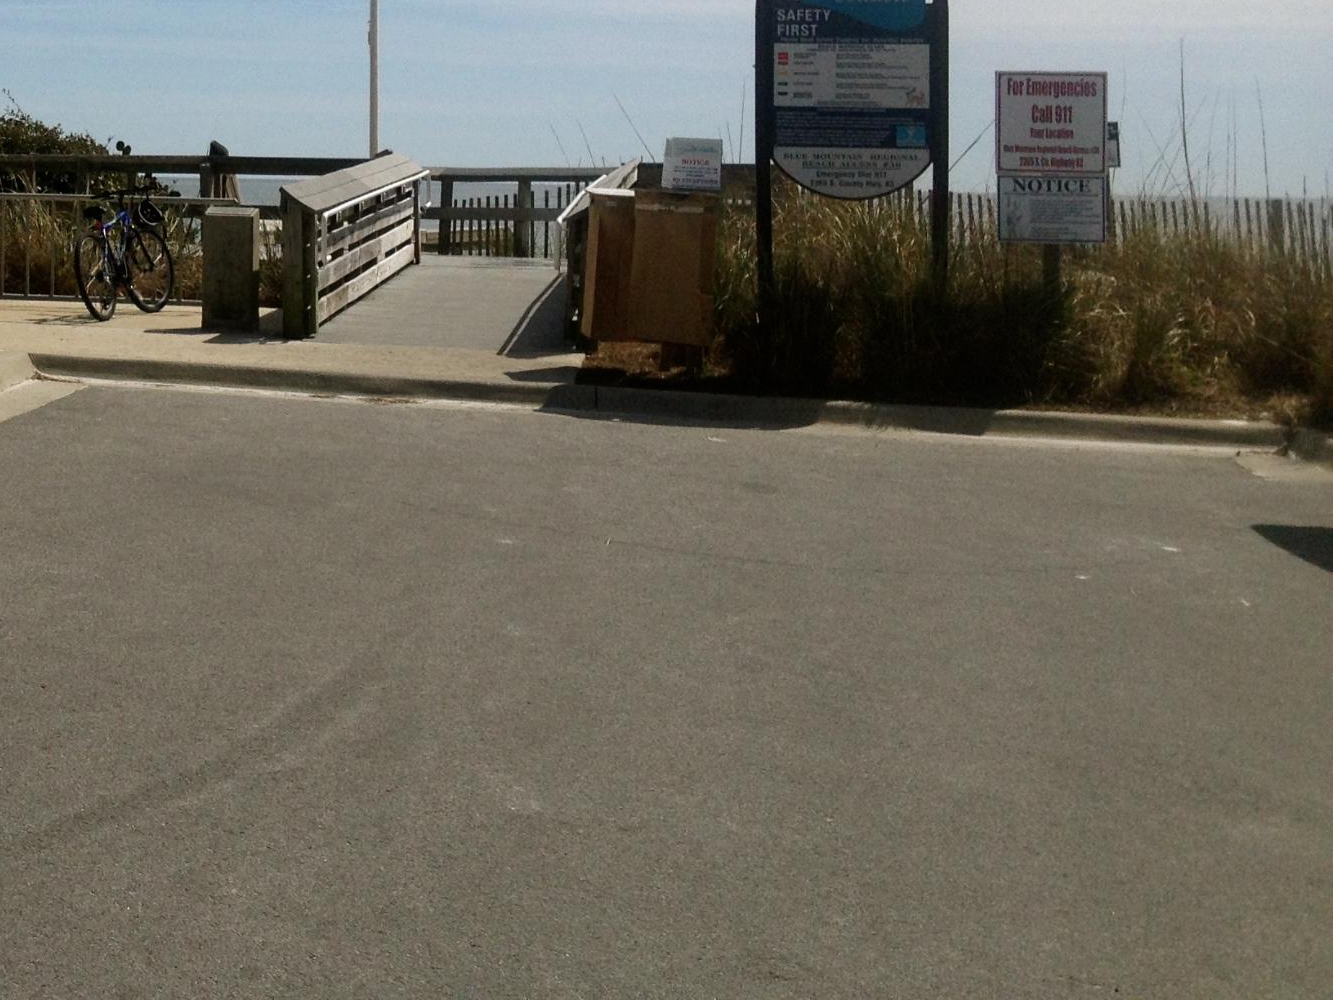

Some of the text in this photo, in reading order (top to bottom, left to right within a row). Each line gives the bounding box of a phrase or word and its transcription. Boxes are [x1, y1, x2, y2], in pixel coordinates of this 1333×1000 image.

[777, 8, 831, 21] SAFETY
[777, 24, 818, 36] FIRST
[1007, 78, 1097, 98] For Emergencies
[1031, 104, 1073, 123] Call 911
[1046, 128, 1074, 138] Location
[682, 158, 709, 166] NOTICE
[816, 171, 855, 179] Emergency
[1012, 179, 1091, 193] NOTICE
